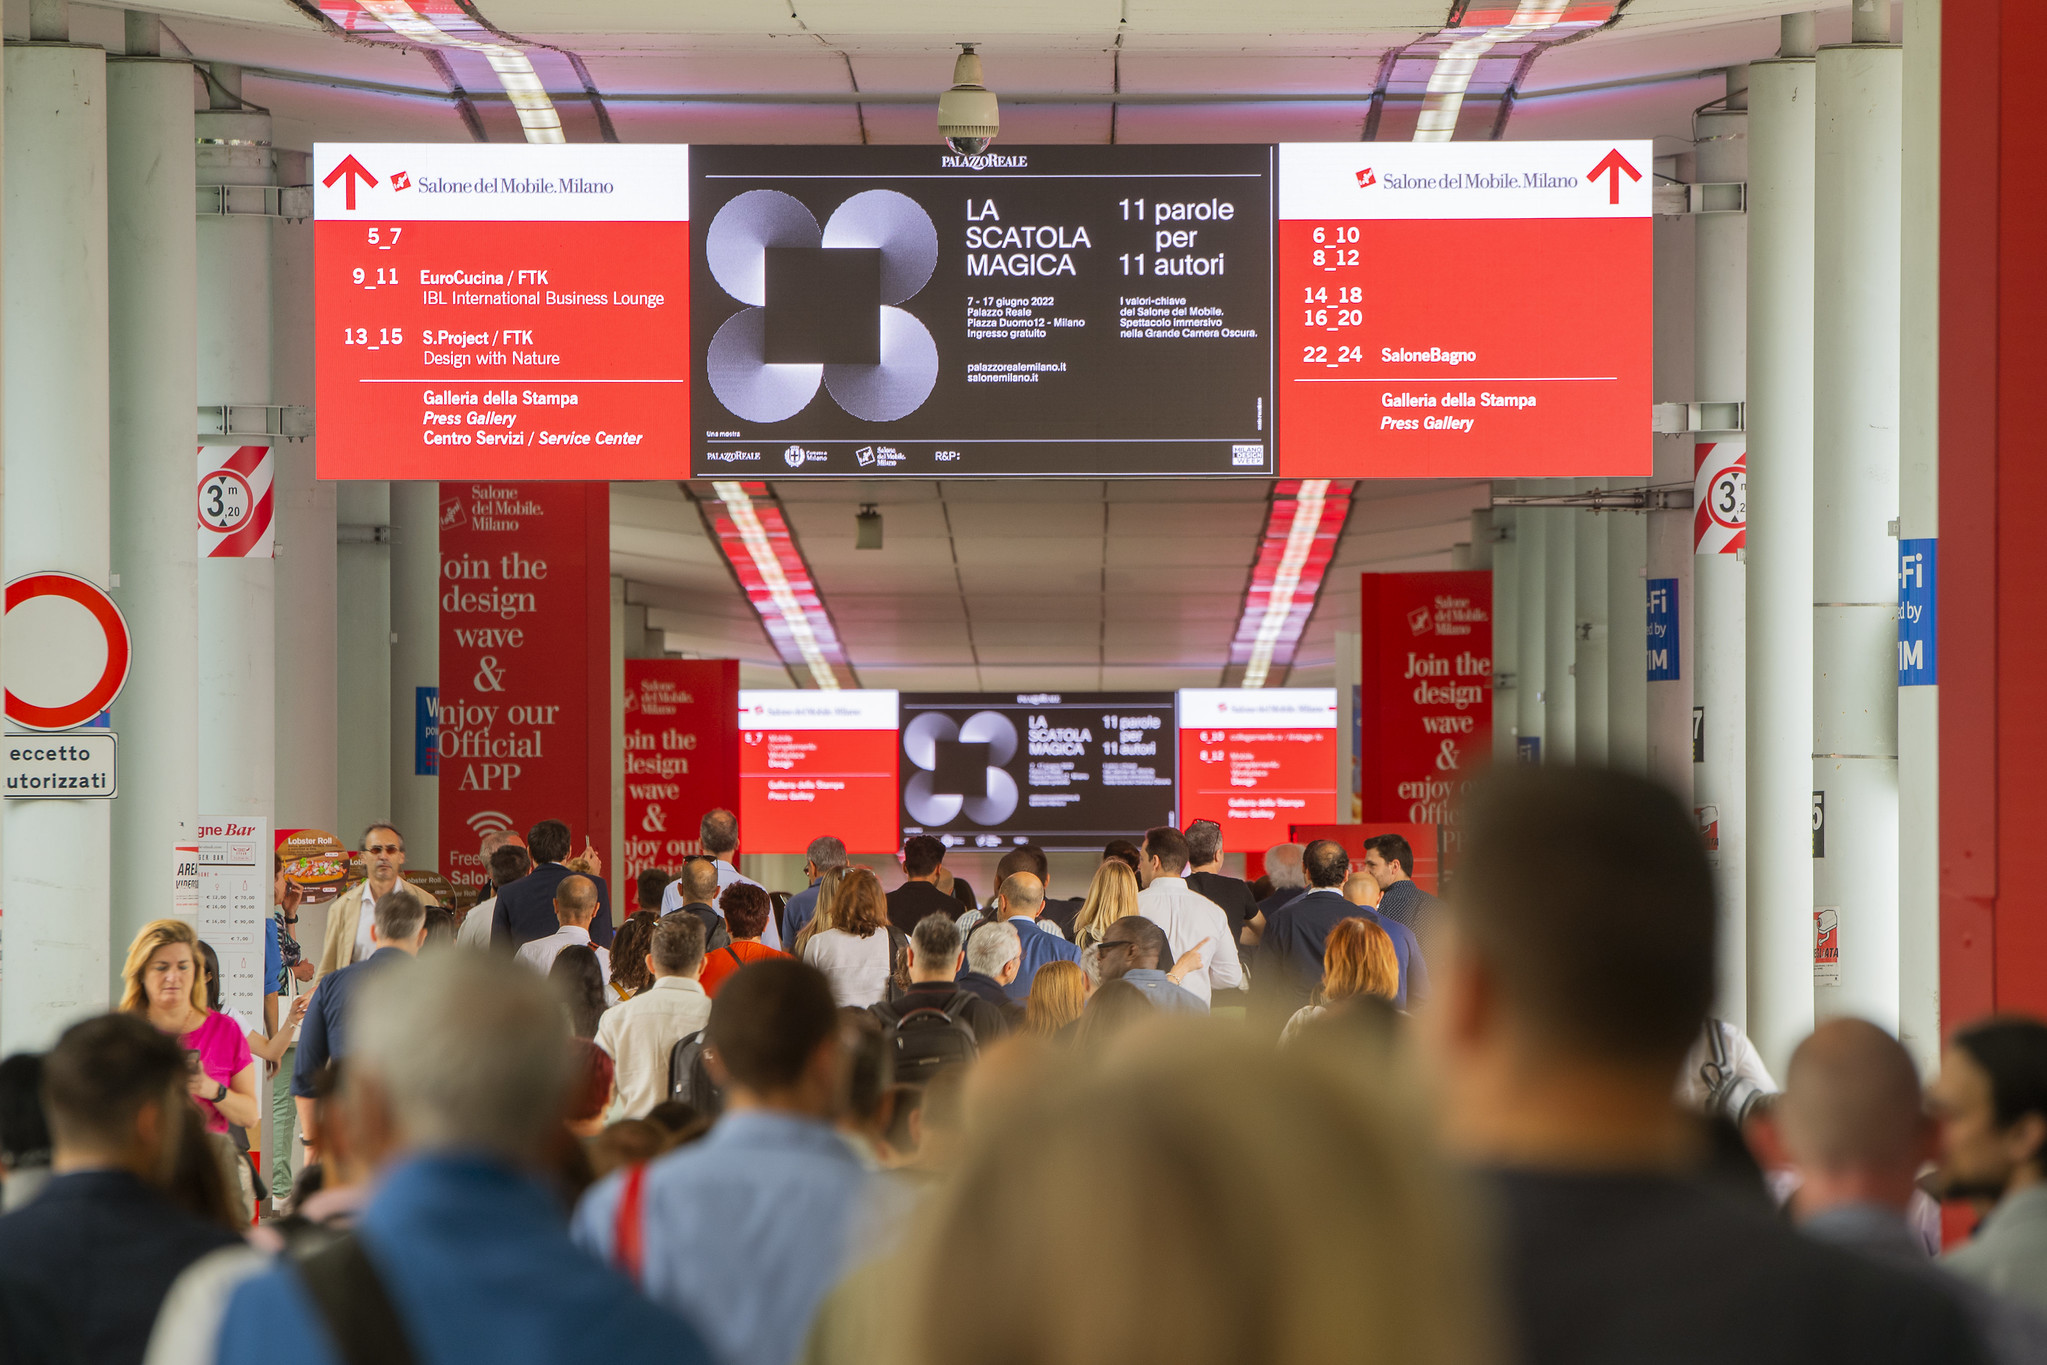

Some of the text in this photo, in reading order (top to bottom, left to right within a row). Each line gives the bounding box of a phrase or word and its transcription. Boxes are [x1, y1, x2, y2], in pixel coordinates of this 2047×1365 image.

[418, 177, 614, 194] Salone del Mobile. Milano
[1383, 171, 1578, 190] Salone del Mobile. Milano
[966, 198, 1000, 221] LA
[1119, 198, 1235, 225] 11 parole
[367, 228, 402, 250] 5_7
[966, 226, 1091, 249] SCATOLA
[1155, 229, 1198, 252] per
[1312, 227, 1360, 248] 6_10
[966, 253, 1076, 276] MAGICA
[1119, 253, 1225, 276] 11 autori
[1312, 250, 1360, 271] 8_12
[352, 268, 549, 290] 9_11 EuroCucina / FTK
[423, 291, 665, 308] IBL International Business Lounge
[967, 297, 974, 306] 7
[983, 297, 994, 306] 17
[996, 297, 1029, 308] giugno
[1031, 297, 1054, 306] 2022
[1125, 296, 1186, 306] valori-chiave
[1303, 287, 1363, 309] 14_18
[967, 307, 1032, 317] Palazzo Reale
[1120, 307, 1224, 316] del Salone del Mobile.
[1303, 309, 1363, 331] 16_20
[967, 318, 997, 328] Piazza
[999, 318, 1045, 327] Duomo12
[1053, 318, 1085, 327] Milano
[1120, 318, 1222, 329] Spettacolo immersivo
[344, 328, 534, 350] 13_15 S.Project / FTK
[967, 329, 1046, 340] Ingresso gratuito
[1120, 328, 1258, 338] nella Grande Camera Oscura.
[424, 351, 560, 369] Design with Nature
[1303, 346, 1476, 368] 22_24 SaloneBagno
[967, 362, 1066, 373] palazzorealemilano.it
[967, 373, 1039, 382] salonemilano.it
[423, 391, 578, 409] Galleria della Stampa
[1381, 393, 1537, 409] Galleria della Stampa
[423, 411, 516, 428] Press Gallery
[1380, 416, 1474, 432] Press Gallery
[423, 430, 643, 446] Centro Servizi / Service Center
[228, 487, 238, 495] m
[472, 485, 518, 499] Salone
[1719, 481, 1736, 513] 3
[207, 485, 224, 517] 3
[472, 501, 544, 515] del Mobile.
[472, 517, 519, 531] Milano
[502, 552, 547, 580] the
[443, 586, 537, 619] design
[1434, 596, 1470, 608] Salone
[1434, 609, 1452, 621] del
[1907, 601, 1922, 623] by
[456, 627, 524, 648] wave
[1435, 623, 1471, 635] Milano
[1404, 651, 1490, 679] Join the
[473, 656, 505, 692] &
[641, 680, 675, 691] Salone
[641, 692, 656, 703] del
[1413, 681, 1482, 709] design
[439, 699, 499, 732] njoy
[508, 705, 559, 725] our
[641, 705, 677, 715] Milano
[1028, 715, 1048, 729] LA
[1102, 715, 1161, 731] 11 parole
[1422, 715, 1474, 733] wave
[624, 729, 697, 750] oin the
[1028, 728, 1092, 742] SCATOLA
[1120, 730, 1144, 744] per
[10, 745, 90, 761] eccetto
[438, 731, 543, 759] Official
[1028, 742, 1085, 756] MAGICA
[1102, 741, 1156, 755] 11 autori
[1436, 739, 1459, 770] &
[6, 773, 106, 789] utorizzati
[458, 764, 521, 791] APP
[629, 782, 680, 800] wave
[1398, 775, 1453, 804] enjoy
[642, 803, 667, 832] &
[225, 823, 256, 836] Bar
